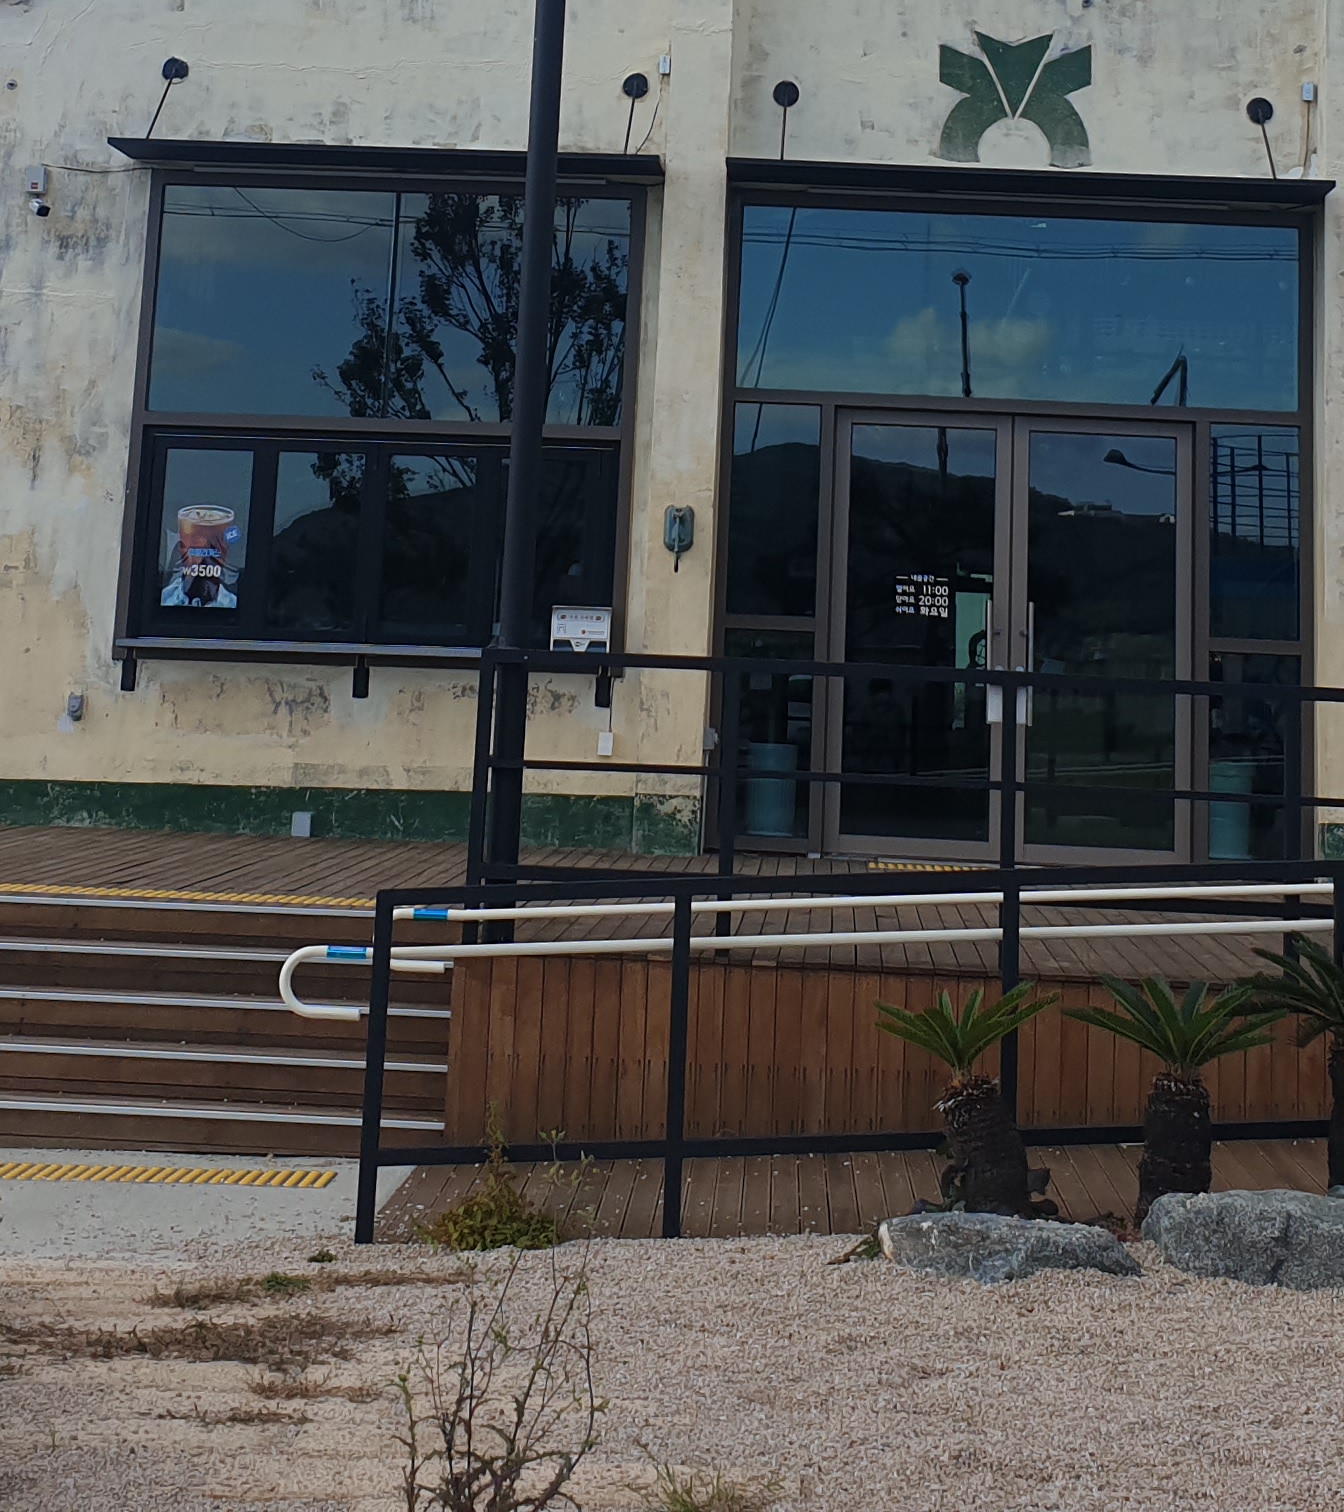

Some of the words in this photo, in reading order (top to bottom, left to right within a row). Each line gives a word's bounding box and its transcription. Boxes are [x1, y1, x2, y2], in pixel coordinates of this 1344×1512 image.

[923, 584, 949, 595] 11:00
[918, 595, 949, 606] 20:00
[919, 606, 948, 618] 화요일
